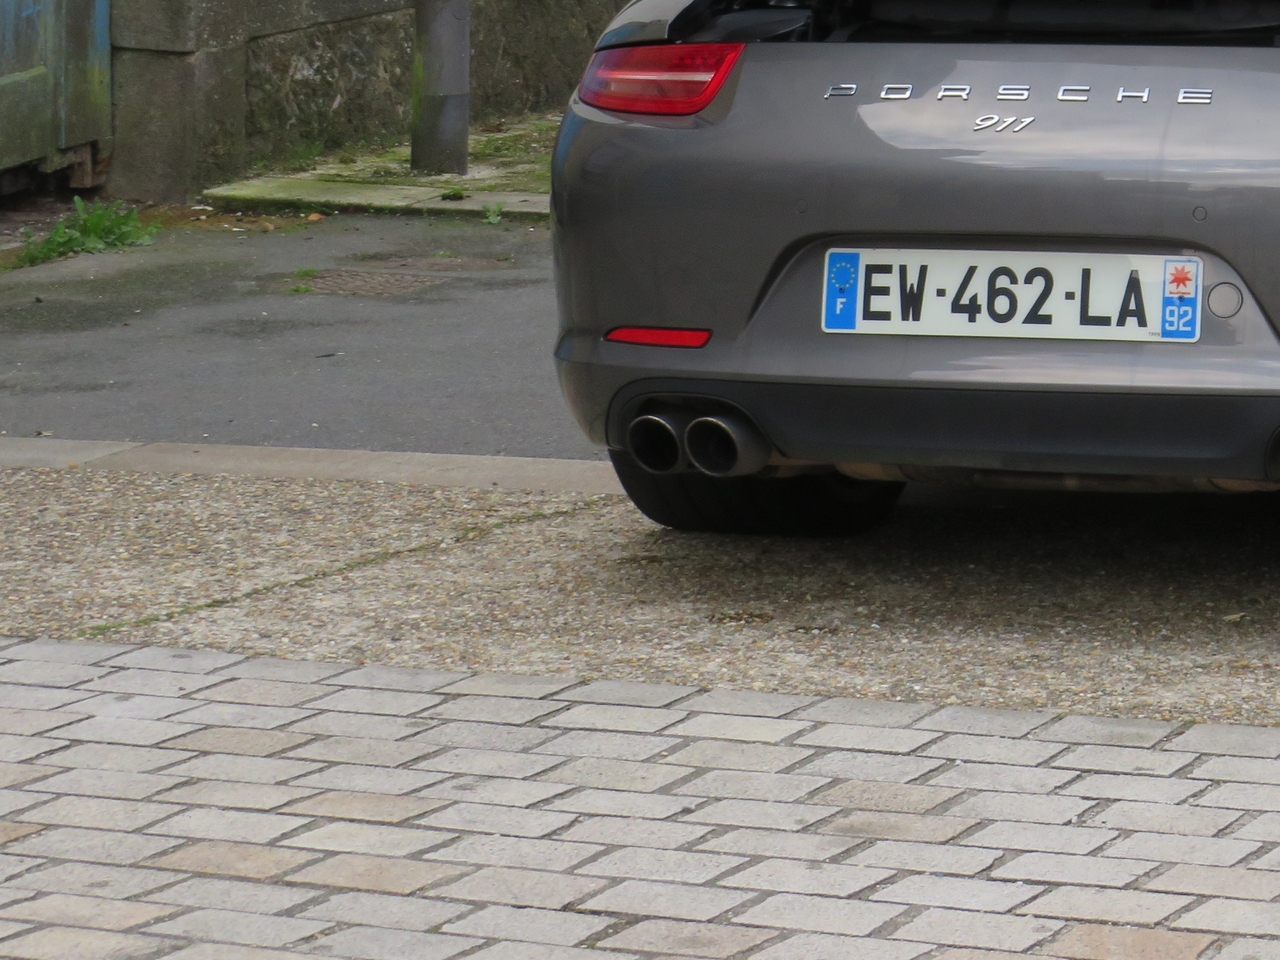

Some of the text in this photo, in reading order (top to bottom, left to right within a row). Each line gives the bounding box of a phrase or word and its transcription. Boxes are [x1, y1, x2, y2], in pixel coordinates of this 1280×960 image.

[824, 84, 1213, 104] PORSCHE
[973, 114, 1036, 132] 911
[835, 263, 1193, 332] F EW-462-LA 92
